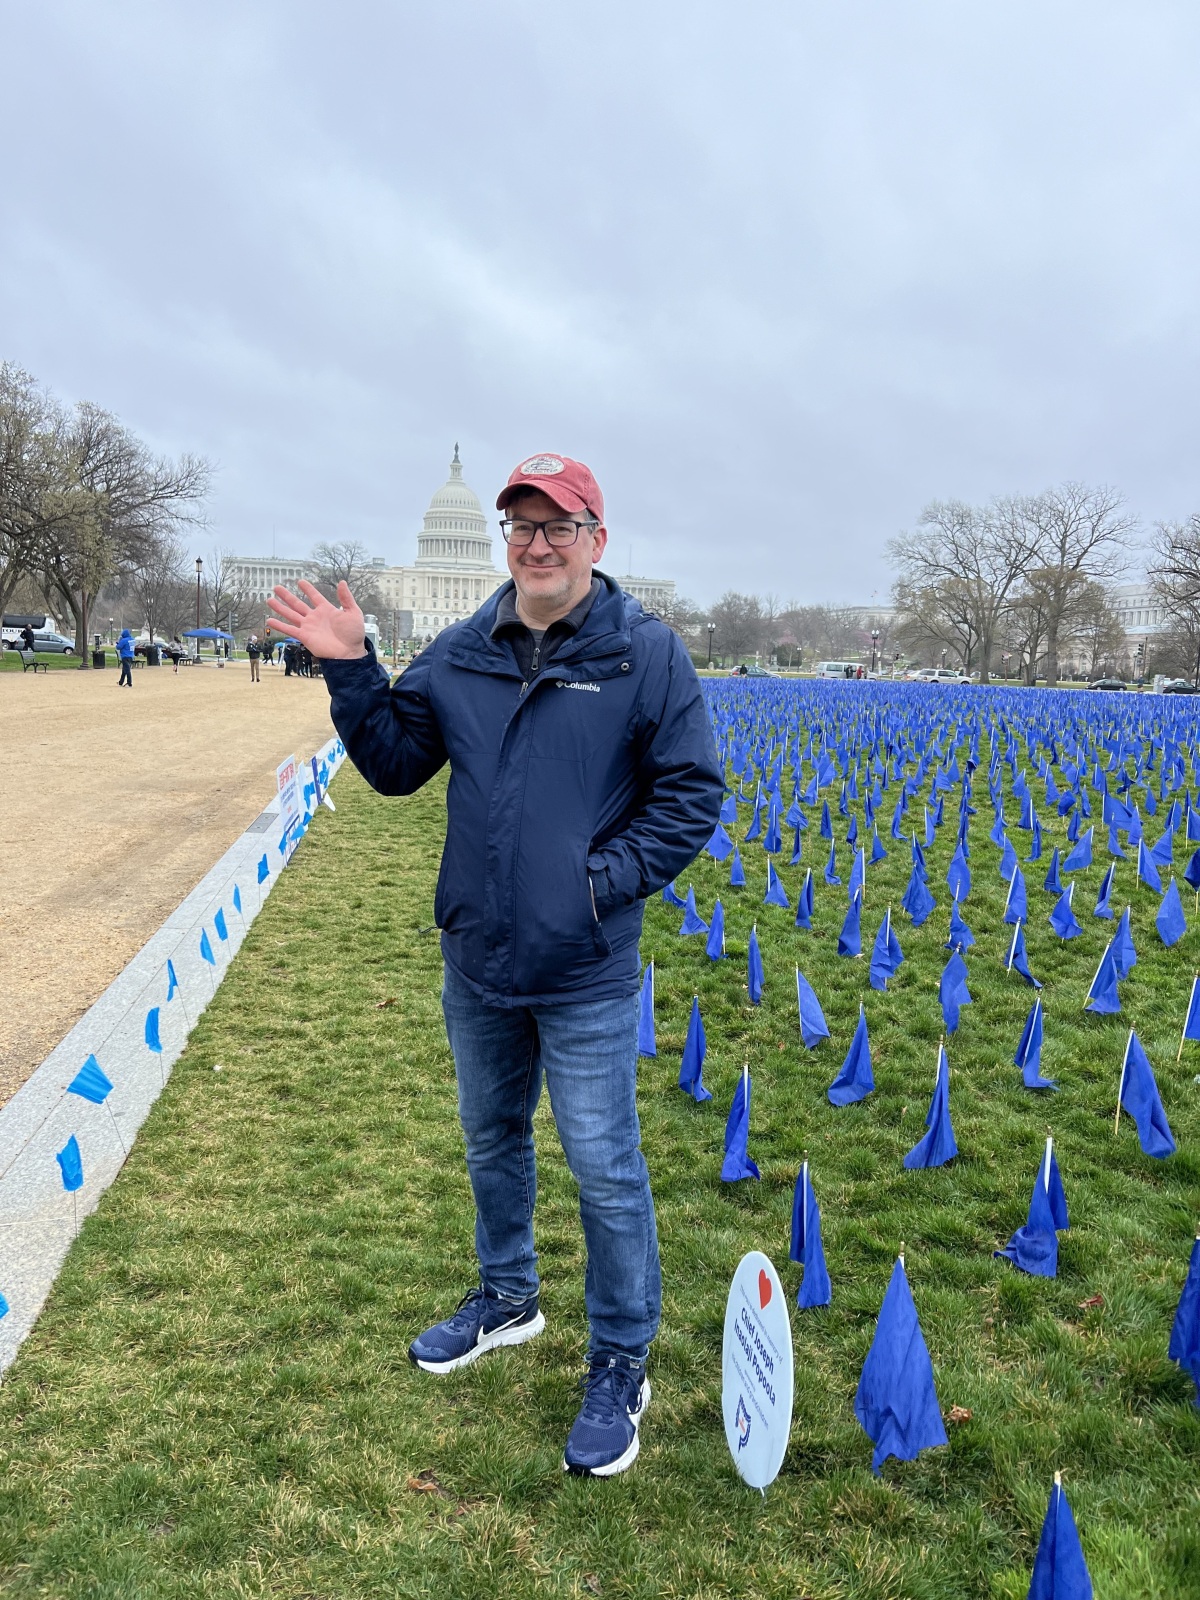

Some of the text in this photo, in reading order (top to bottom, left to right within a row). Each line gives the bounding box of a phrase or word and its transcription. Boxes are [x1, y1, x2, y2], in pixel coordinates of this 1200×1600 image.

[564, 681, 601, 692] Columbia
[742, 1307, 774, 1375] Chief Joseph
[752, 1354, 776, 1406] Popoola
